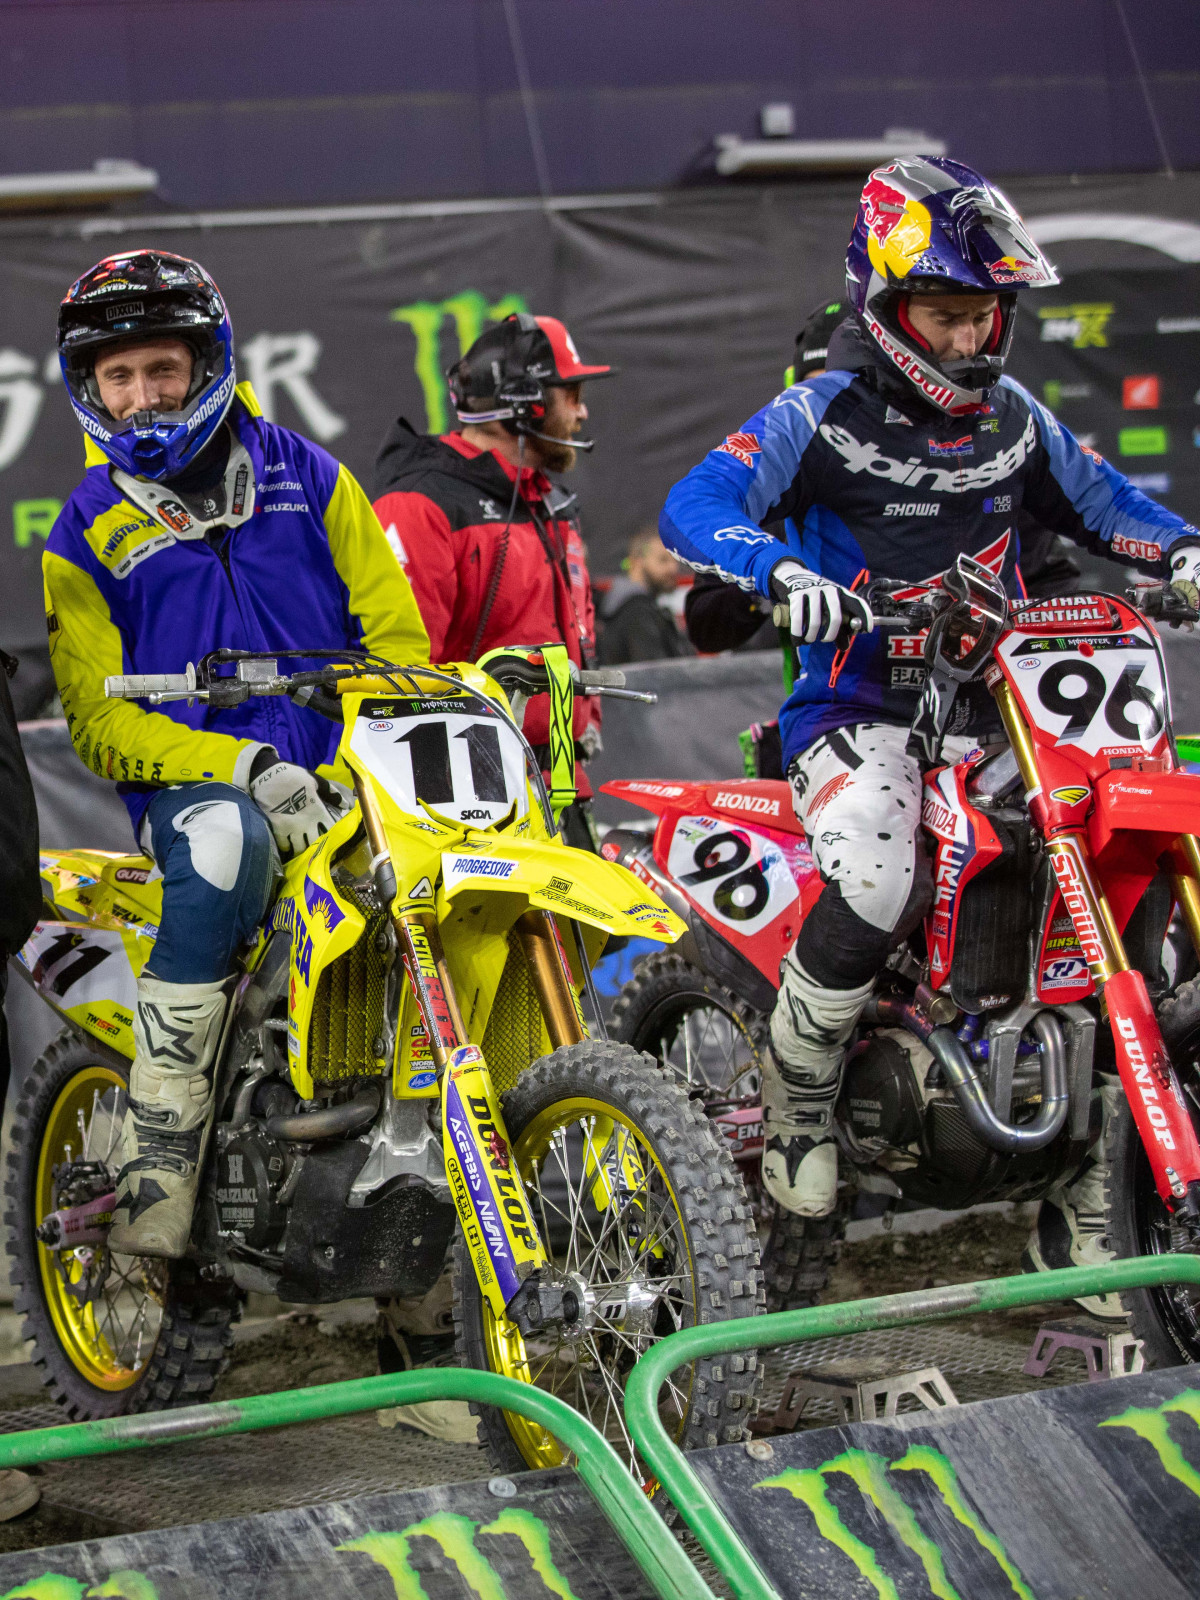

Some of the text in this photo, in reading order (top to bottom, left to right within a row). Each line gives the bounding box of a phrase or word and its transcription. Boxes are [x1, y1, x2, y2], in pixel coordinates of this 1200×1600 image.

[992, 269, 1046, 284] Red Bull
[81, 283, 148, 300] TWISTED TEA
[107, 303, 144, 318] DIXXON
[869, 321, 957, 408] Red Bull
[264, 503, 309, 513] SUZUKI
[883, 503, 940, 516] SHOWA
[102, 523, 140, 558] TWISTED
[1018, 608, 1104, 624] RENTHAL
[421, 701, 466, 710] MONSTER
[1038, 659, 1164, 747] 96
[1102, 747, 1144, 755] HONDA
[393, 721, 509, 806] 11
[258, 772, 273, 785] FLY
[712, 792, 781, 816] HONDA
[460, 809, 493, 821] SKDA
[116, 869, 148, 882] GUTS
[452, 858, 515, 877] PROGRESSIVE
[677, 830, 769, 921] 96
[935, 844, 965, 905] CRF
[550, 878, 569, 892] DIXXON
[1050, 853, 1106, 965] SHOWA
[408, 923, 439, 979] ACTIVE
[32, 933, 112, 998] 11
[1052, 961, 1076, 977] TJ
[422, 977, 459, 1048] RIDE
[85, 1012, 121, 1035] TWISTED
[1115, 1016, 1176, 1150] DUNLOP
[217, 1188, 258, 1203] SUZUKI
